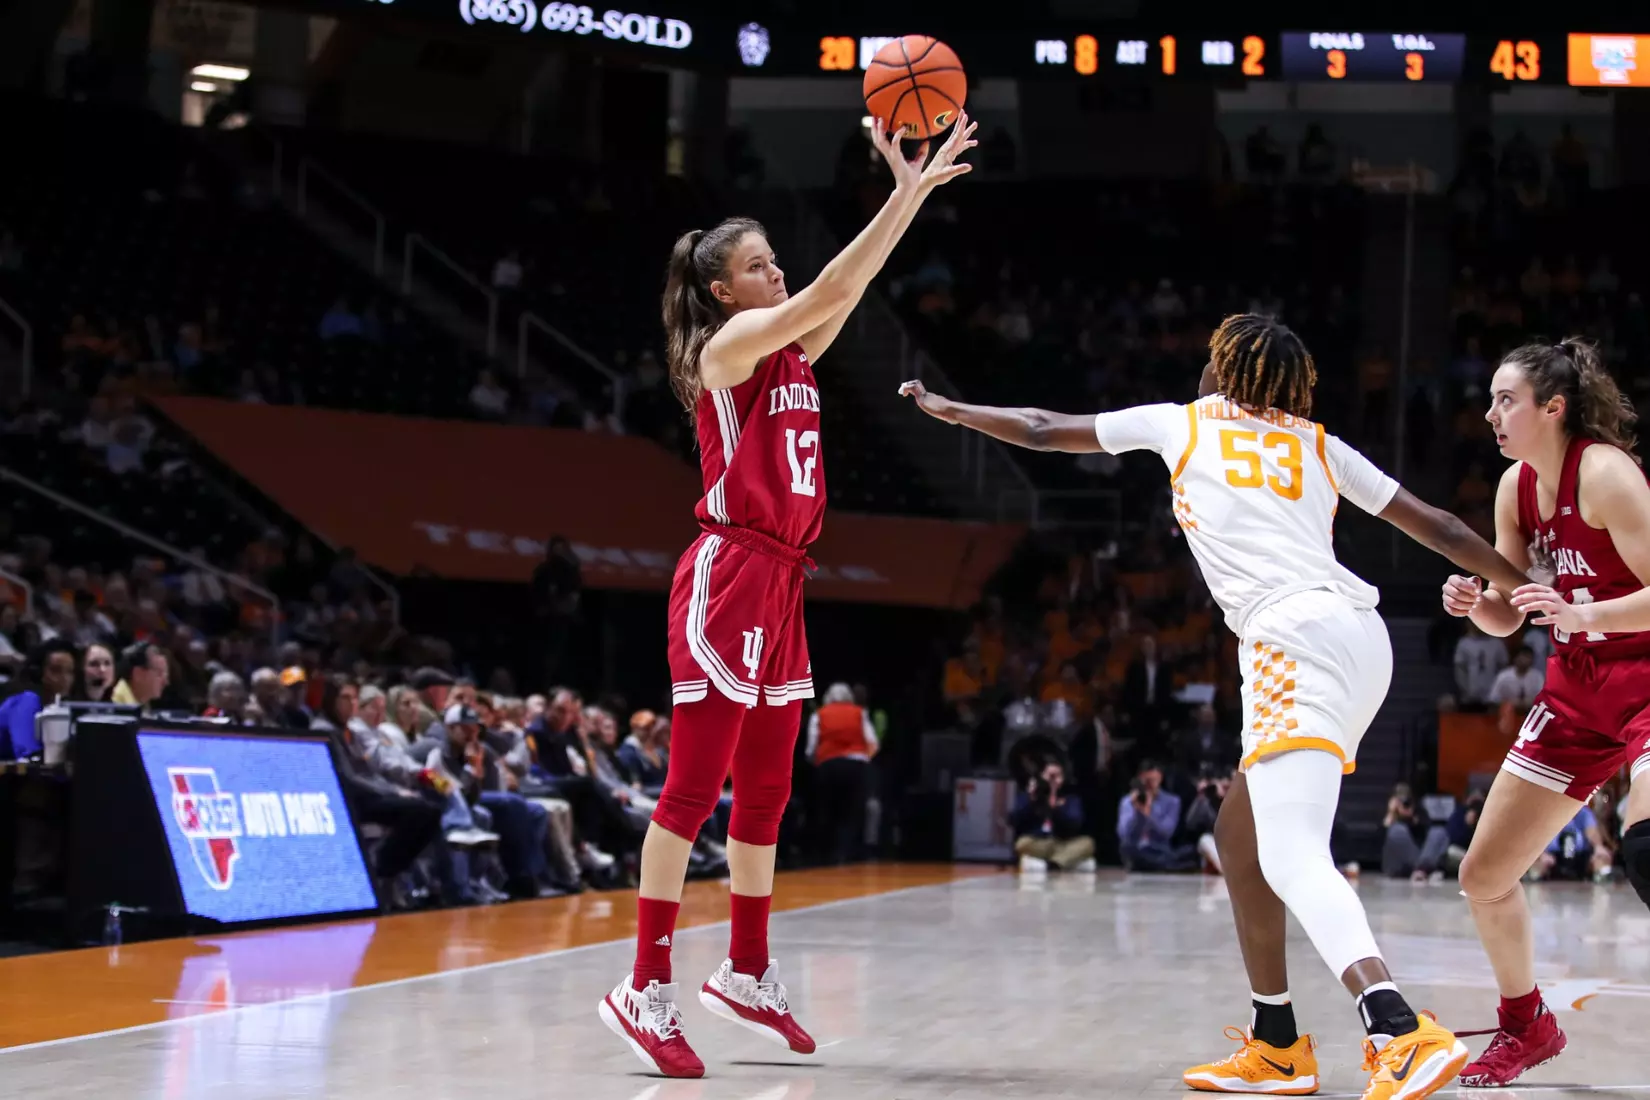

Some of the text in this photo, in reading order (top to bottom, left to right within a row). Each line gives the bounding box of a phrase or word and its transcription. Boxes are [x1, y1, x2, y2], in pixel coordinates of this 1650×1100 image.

[542, 1, 693, 49] 693-SOLD
[1309, 32, 1364, 50] FOULS
[1075, 34, 1098, 75] 8
[1159, 35, 1176, 75] 1
[1242, 35, 1264, 75] 2
[1327, 49, 1346, 78] 3
[1405, 52, 1424, 81] 3
[1490, 41, 1539, 81] 43
[785, 428, 819, 497] 12
[1219, 429, 1303, 501] 53
[283, 792, 336, 836] PARTS
